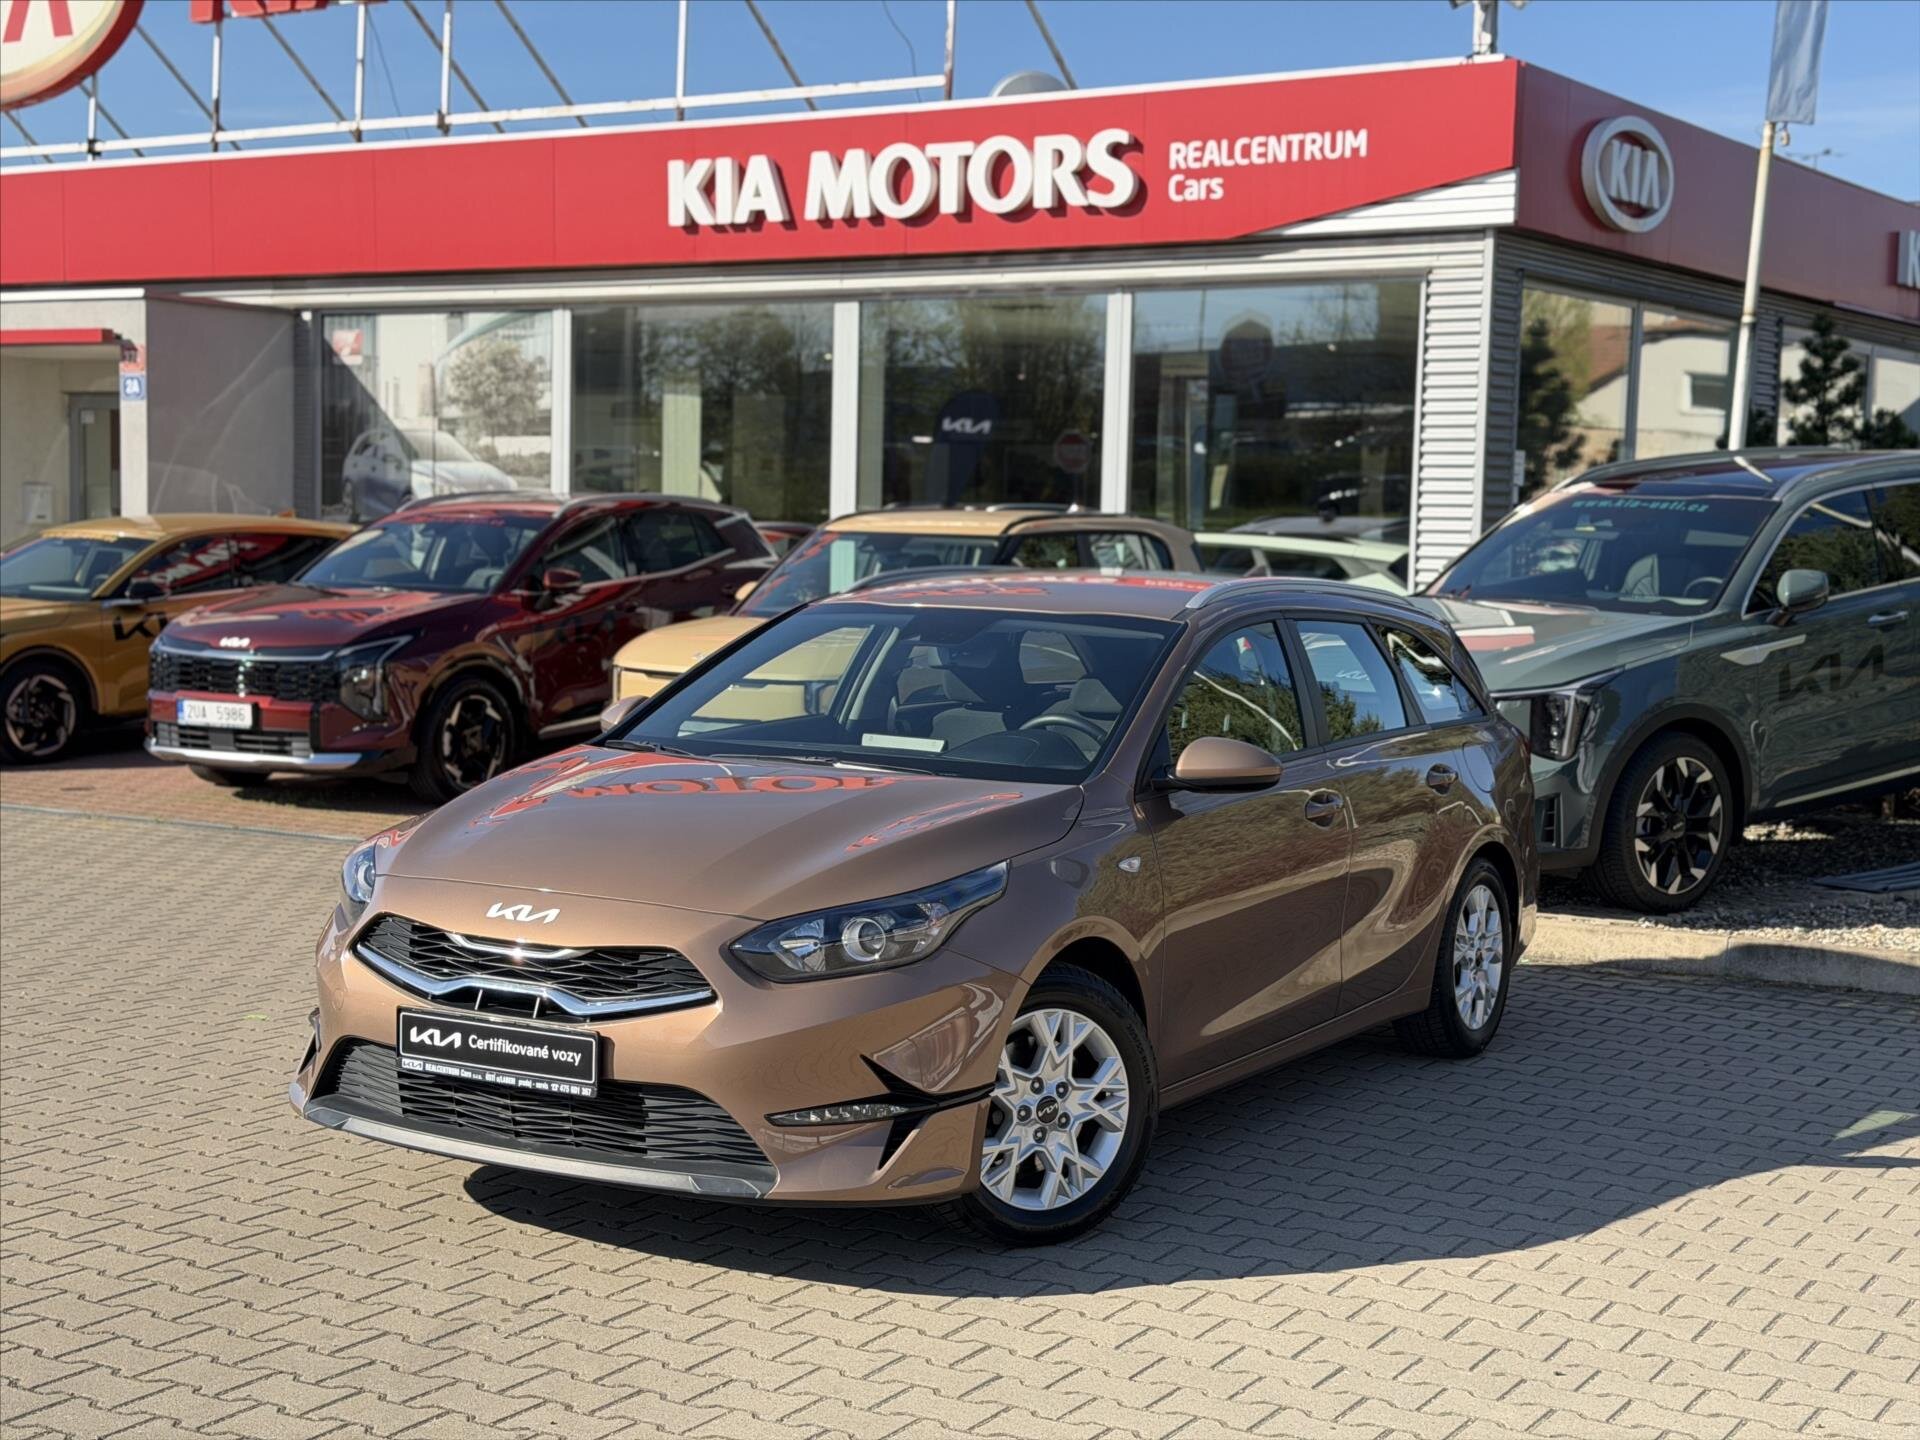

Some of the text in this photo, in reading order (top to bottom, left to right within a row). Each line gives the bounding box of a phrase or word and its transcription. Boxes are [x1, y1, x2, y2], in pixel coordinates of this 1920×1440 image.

[1168, 128, 1368, 170] REALCENTRUM
[668, 128, 1139, 227] KIA MOTORS
[1168, 173, 1224, 202] Cars
[1610, 139, 1661, 209] KIA
[942, 417, 992, 434] KIA
[1778, 644, 1884, 701] KIA
[486, 902, 560, 924] KIA
[410, 1026, 582, 1066] KIA Certifikované vozy
